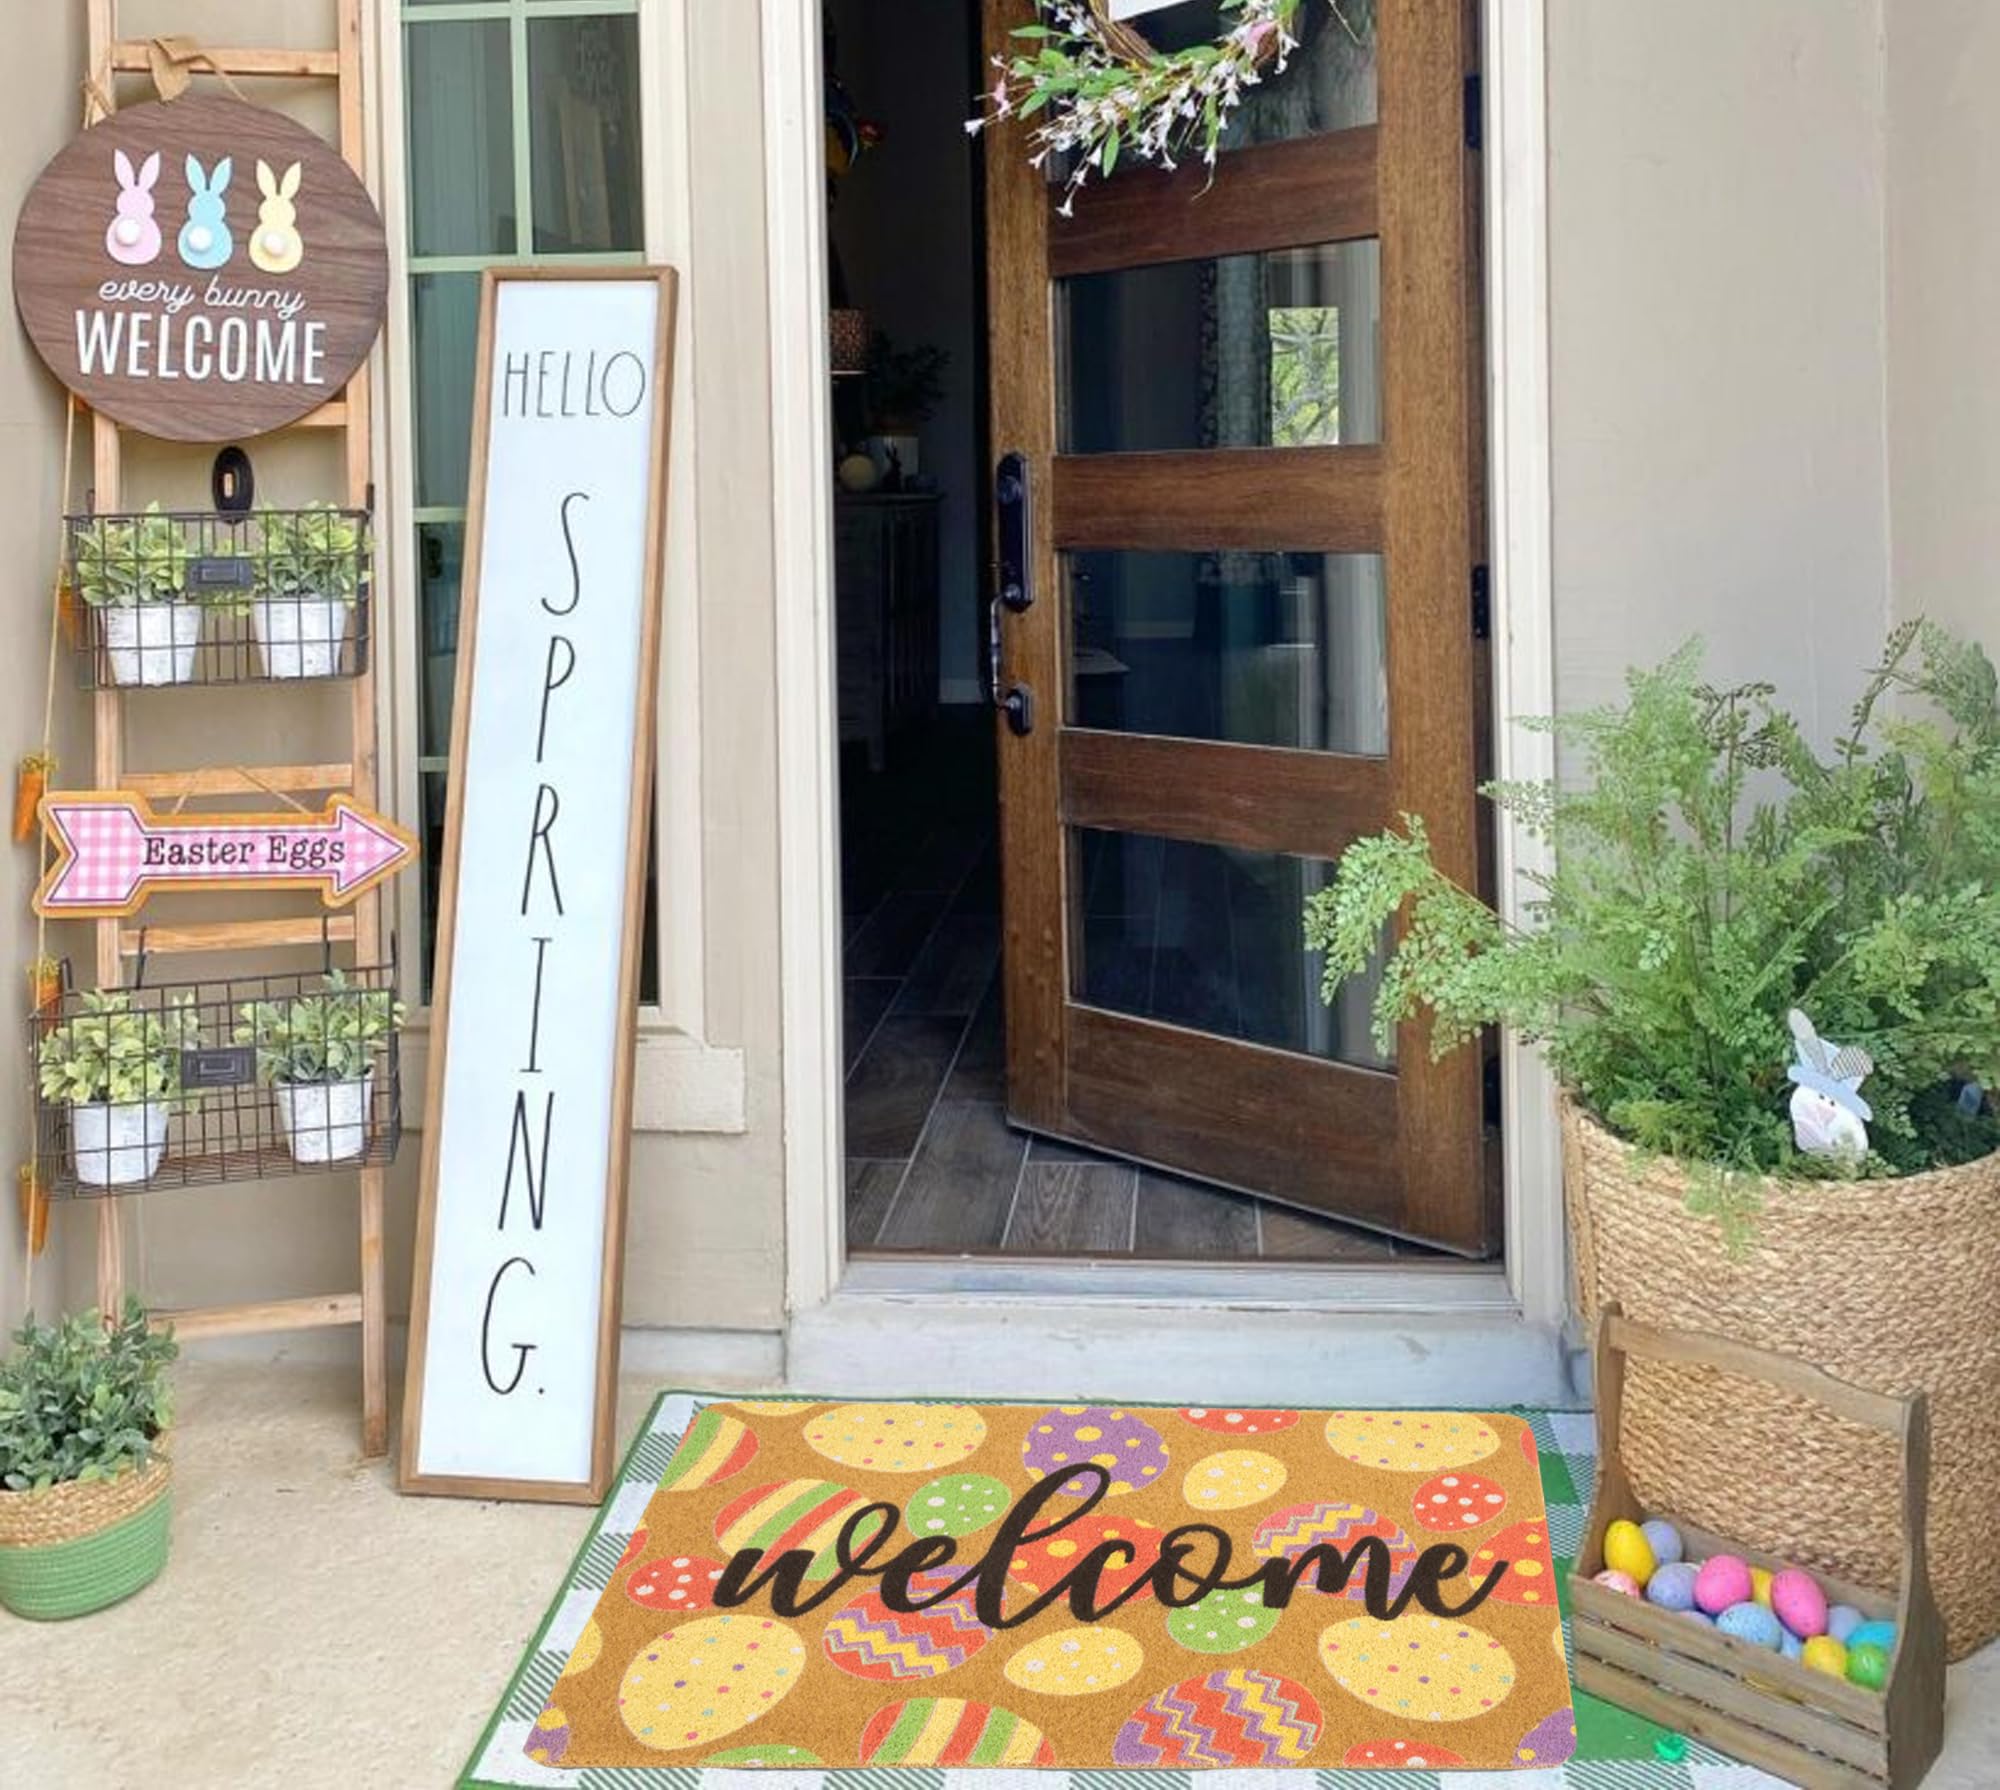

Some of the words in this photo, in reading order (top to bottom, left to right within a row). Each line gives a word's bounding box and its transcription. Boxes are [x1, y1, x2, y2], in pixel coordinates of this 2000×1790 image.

[100, 279, 195, 313] every
[204, 276, 305, 319] bunny
[75, 310, 326, 385] WELCOME
[503, 350, 646, 418] HELLO
[143, 837, 255, 866] Easter
[267, 834, 346, 871] Eggs
[481, 492, 590, 1395] SPRING.
[711, 1461, 1509, 1630] welcome
